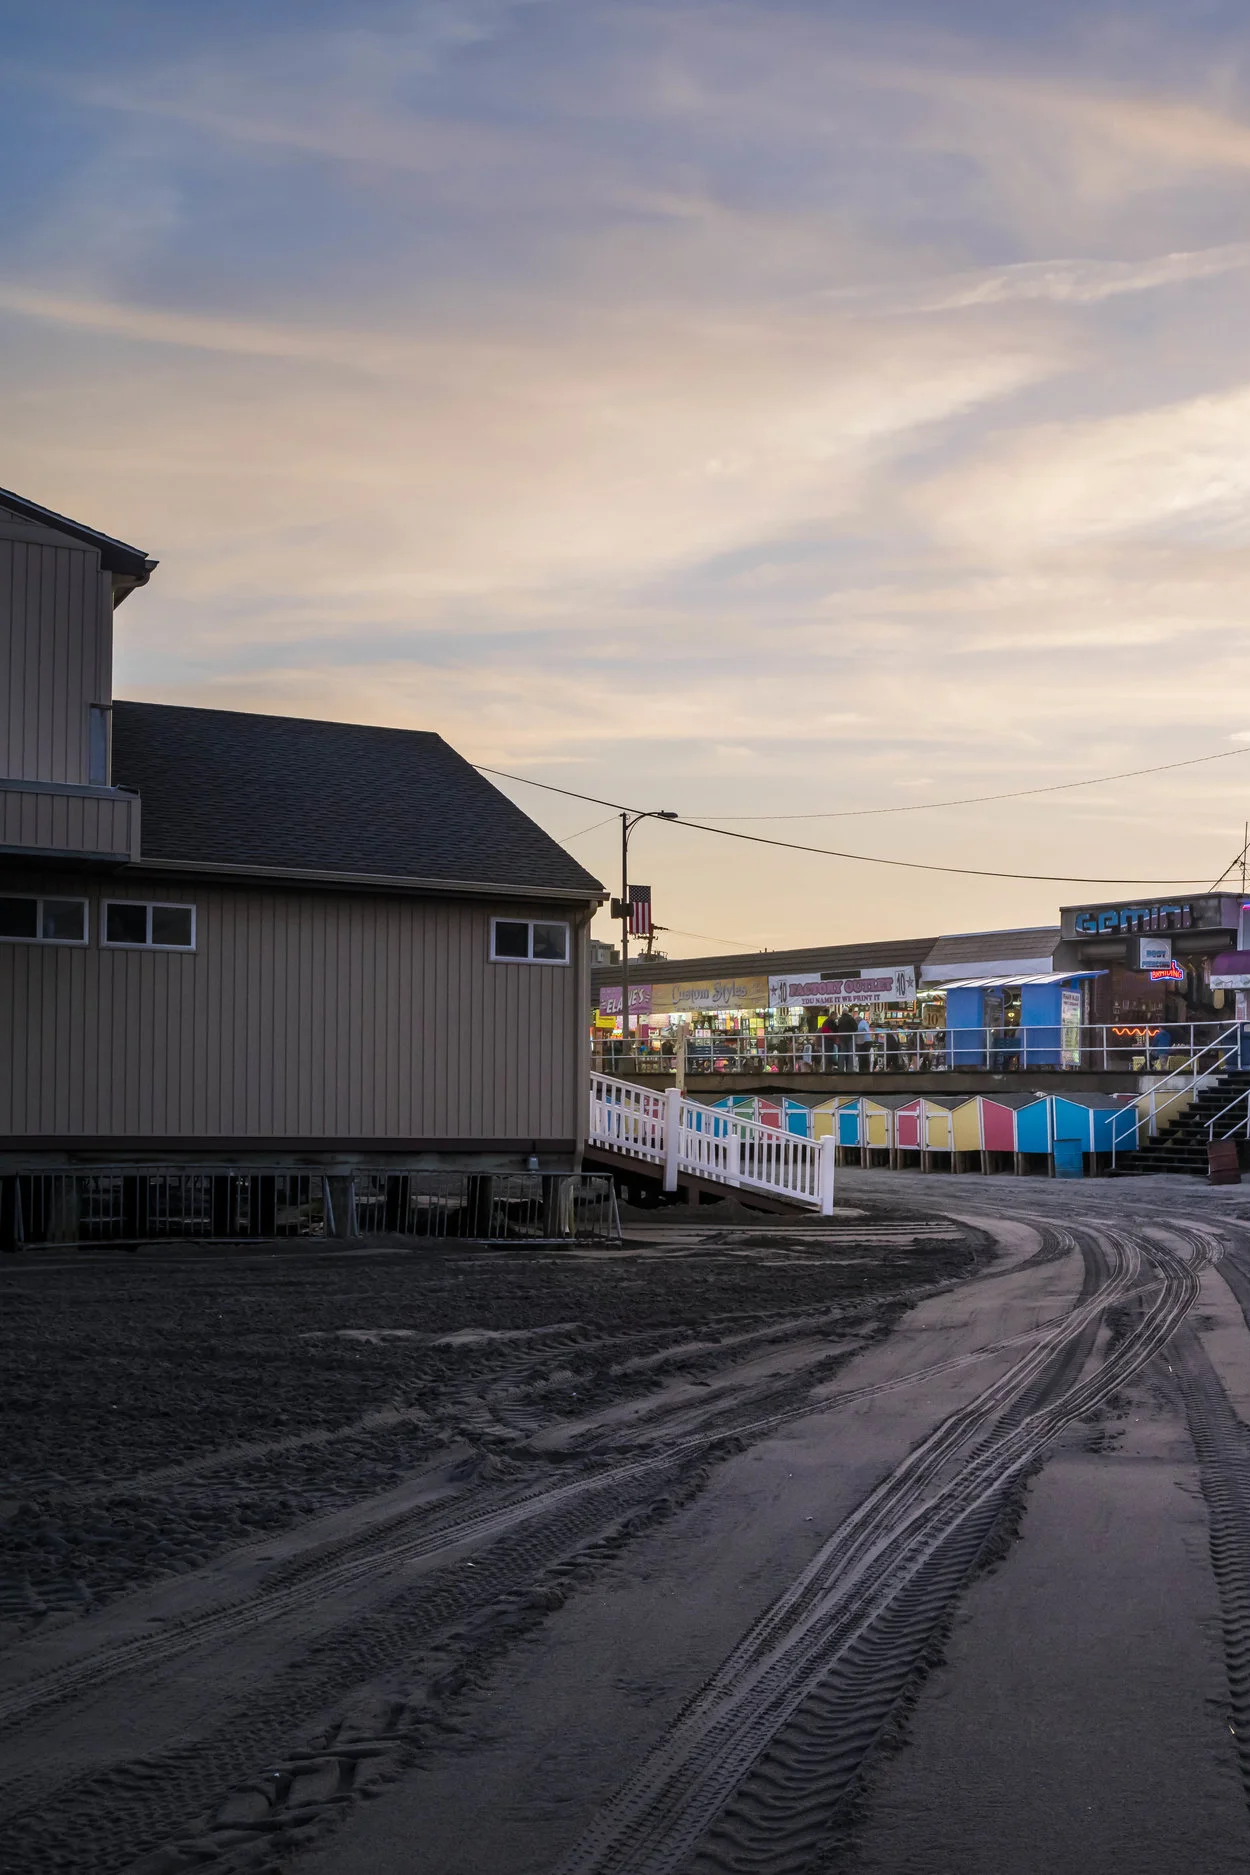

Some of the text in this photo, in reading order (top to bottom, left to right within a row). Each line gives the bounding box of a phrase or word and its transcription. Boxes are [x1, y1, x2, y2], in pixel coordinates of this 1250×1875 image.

[788, 977, 893, 997] FACTORY OUTLET
[606, 988, 644, 1013] ELANE'S
